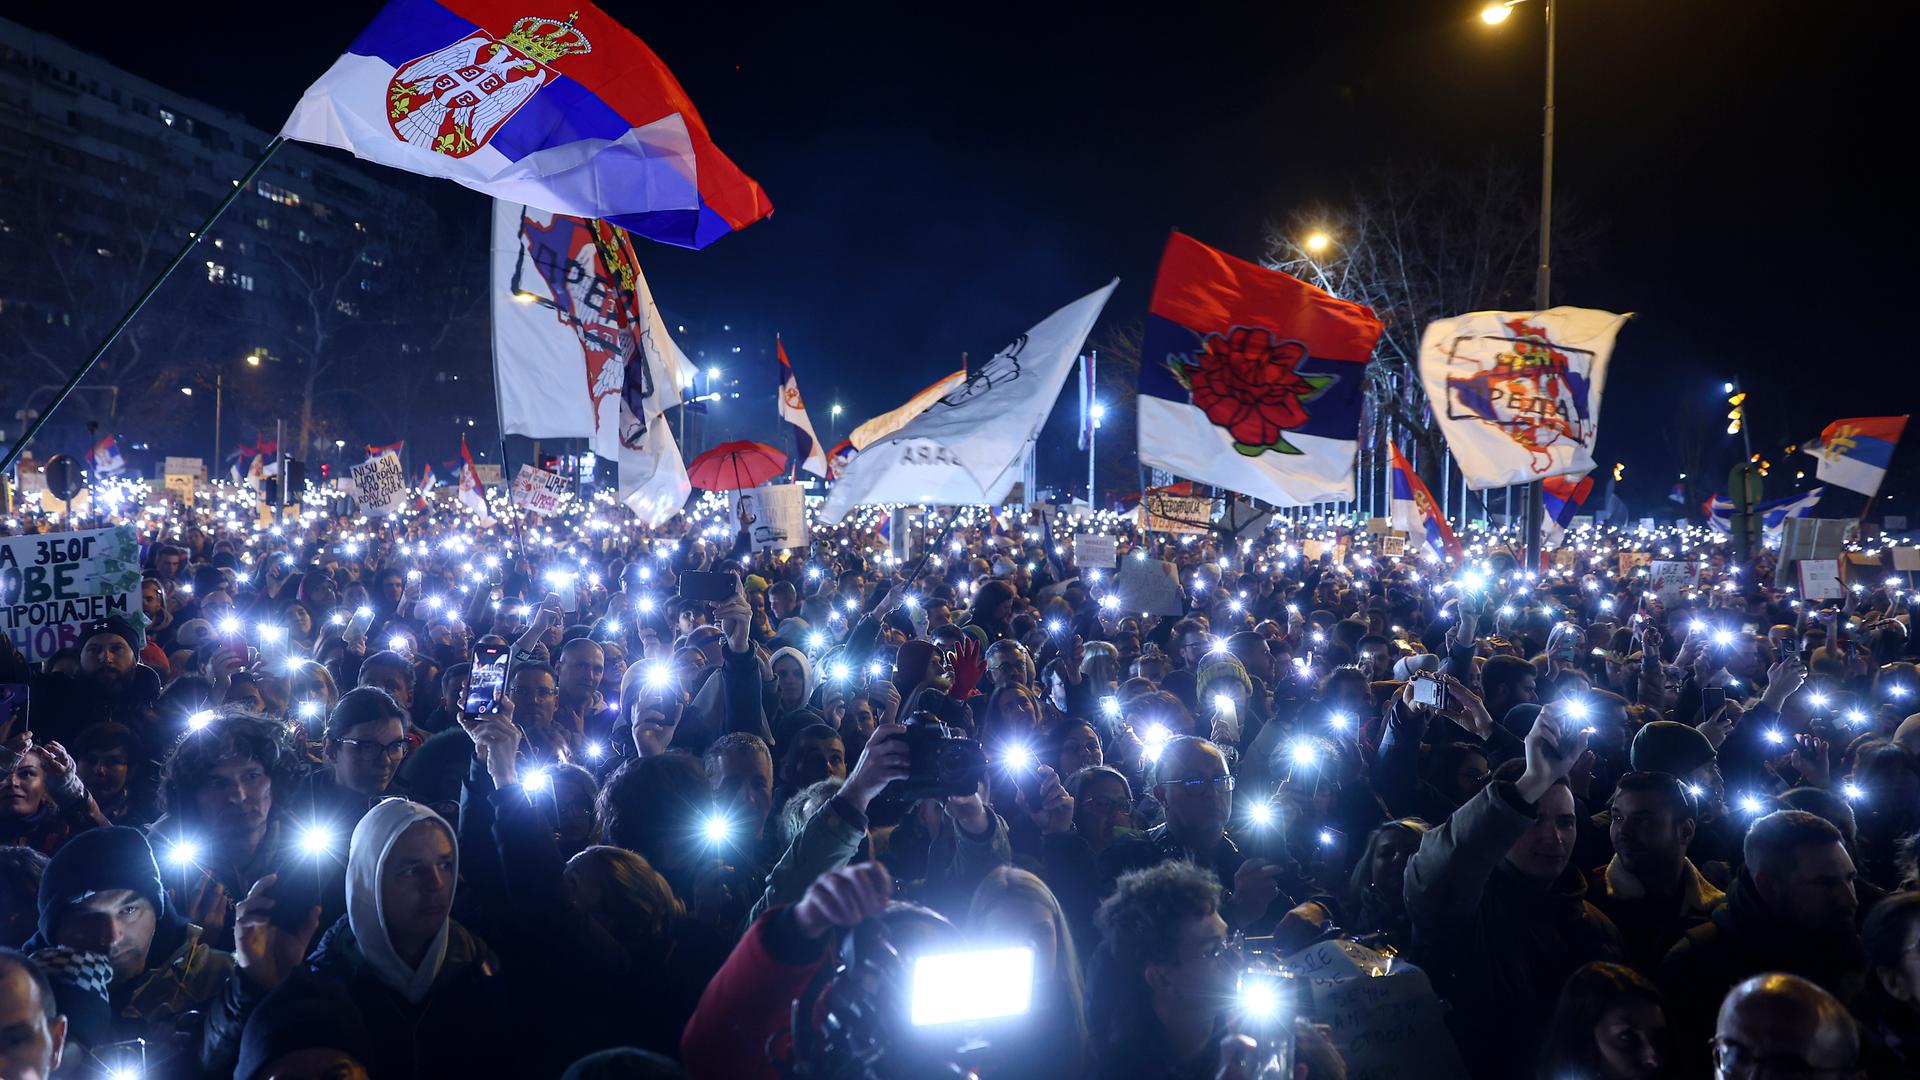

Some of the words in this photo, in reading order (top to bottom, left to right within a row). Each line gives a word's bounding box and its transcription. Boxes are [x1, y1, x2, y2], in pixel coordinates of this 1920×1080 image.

[353, 462, 378, 478] NISU
[380, 455, 394, 469] SVI
[362, 482, 379, 494] KAO
[369, 496, 391, 509] MISLI
[34, 536, 96, 565] ЗБОГ
[10, 622, 88, 662] НОВ
